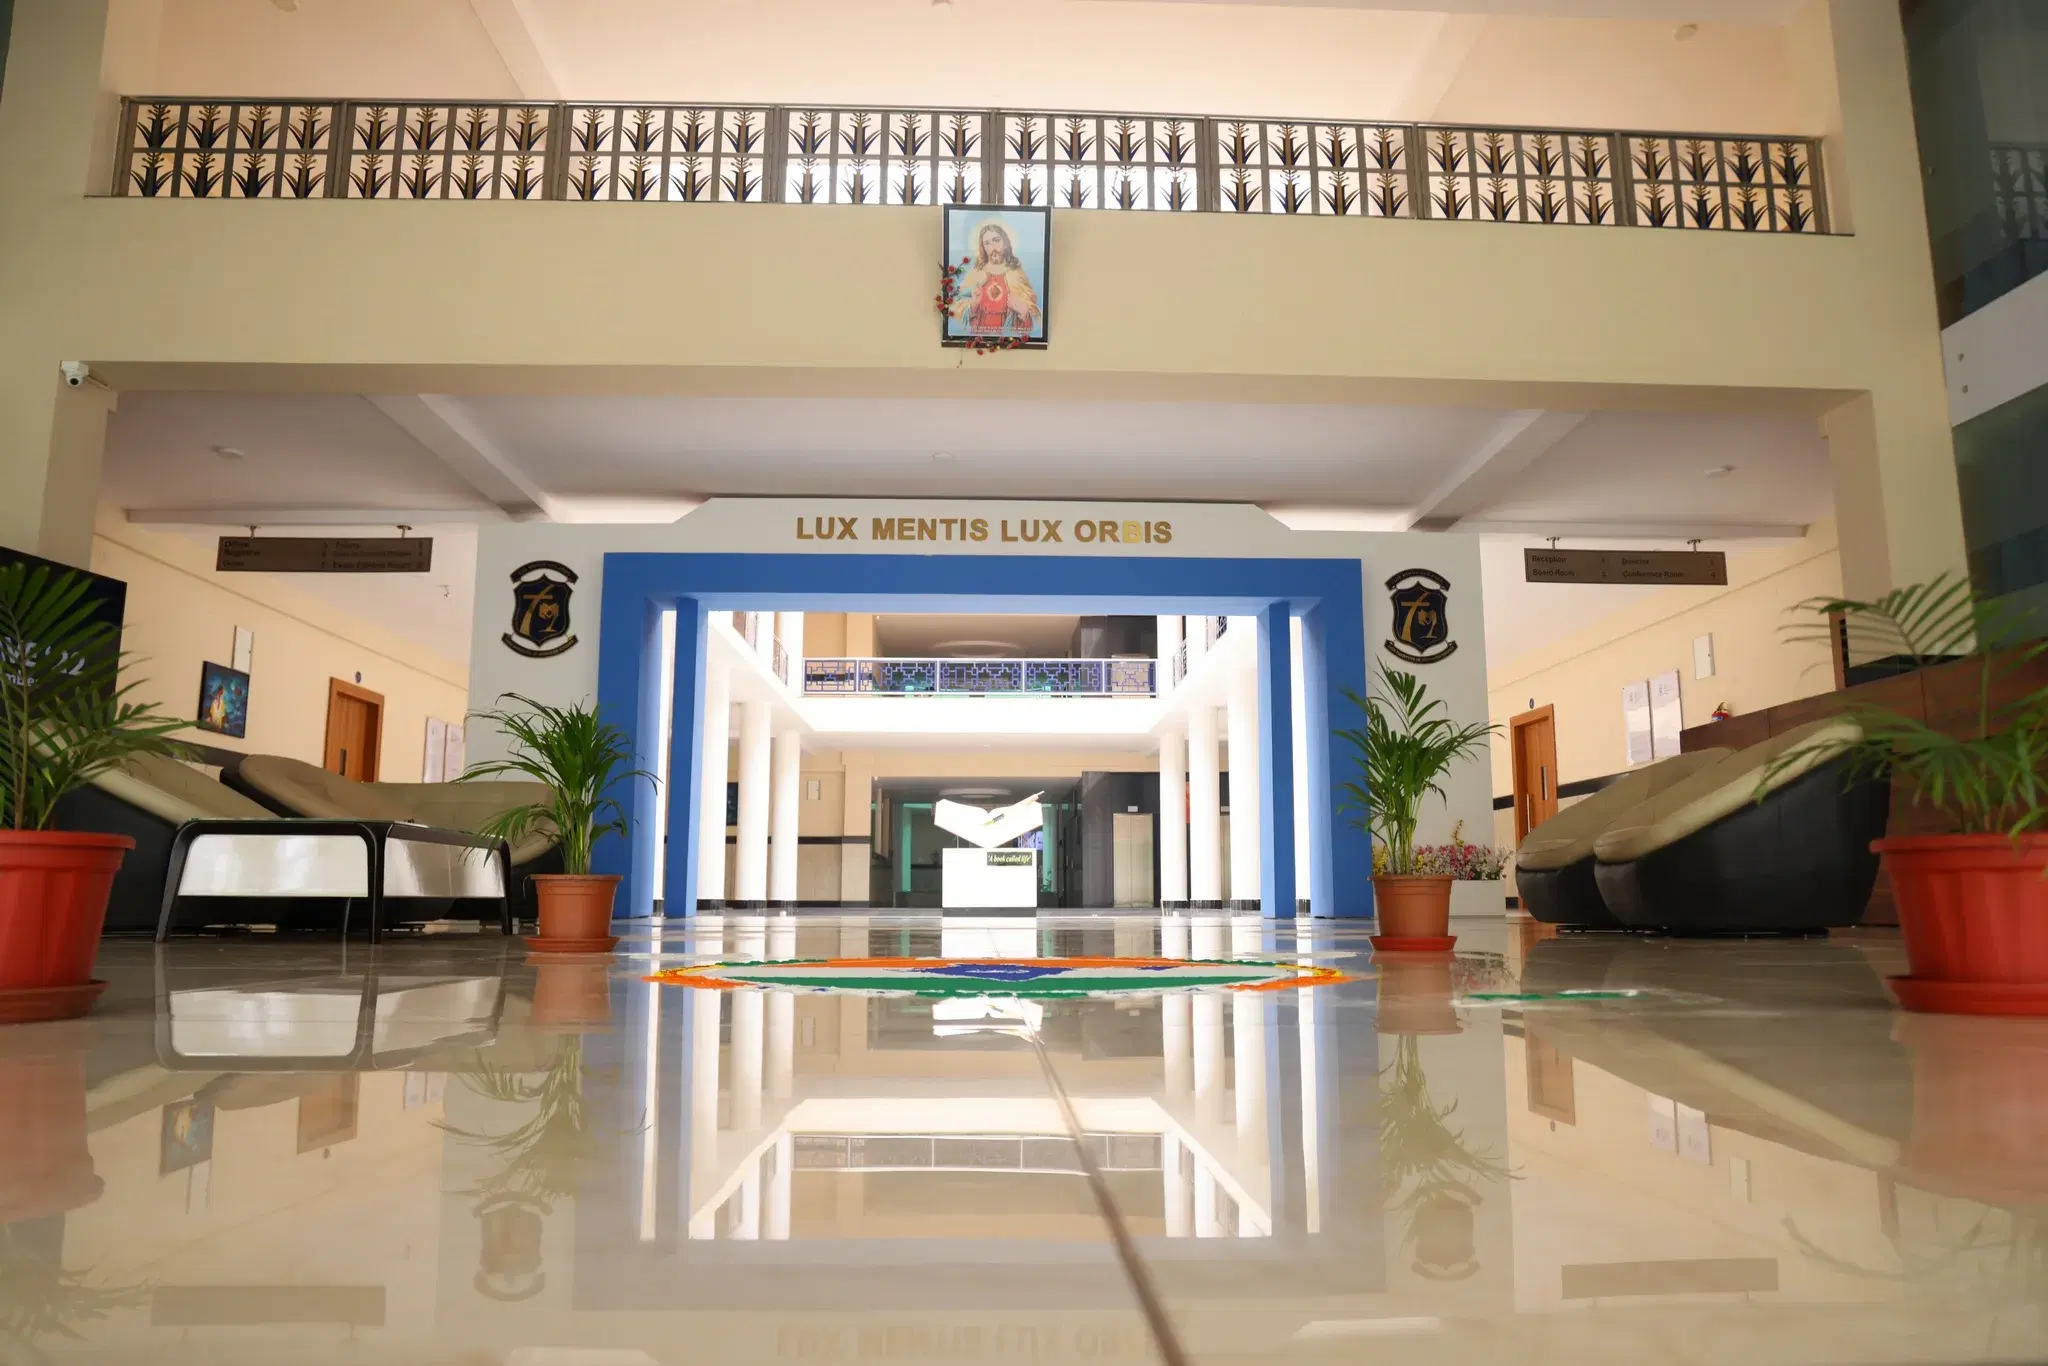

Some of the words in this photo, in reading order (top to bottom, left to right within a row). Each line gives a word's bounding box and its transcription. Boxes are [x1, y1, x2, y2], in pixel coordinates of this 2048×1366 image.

[797, 517, 859, 540] LUX
[872, 517, 989, 542] MENTIS
[1001, 519, 1063, 543] LUX
[1074, 519, 1173, 544] ORBIS
[1532, 555, 1567, 564] Reception
[1532, 568, 1554, 576] Board
[1555, 569, 1576, 577] Room
